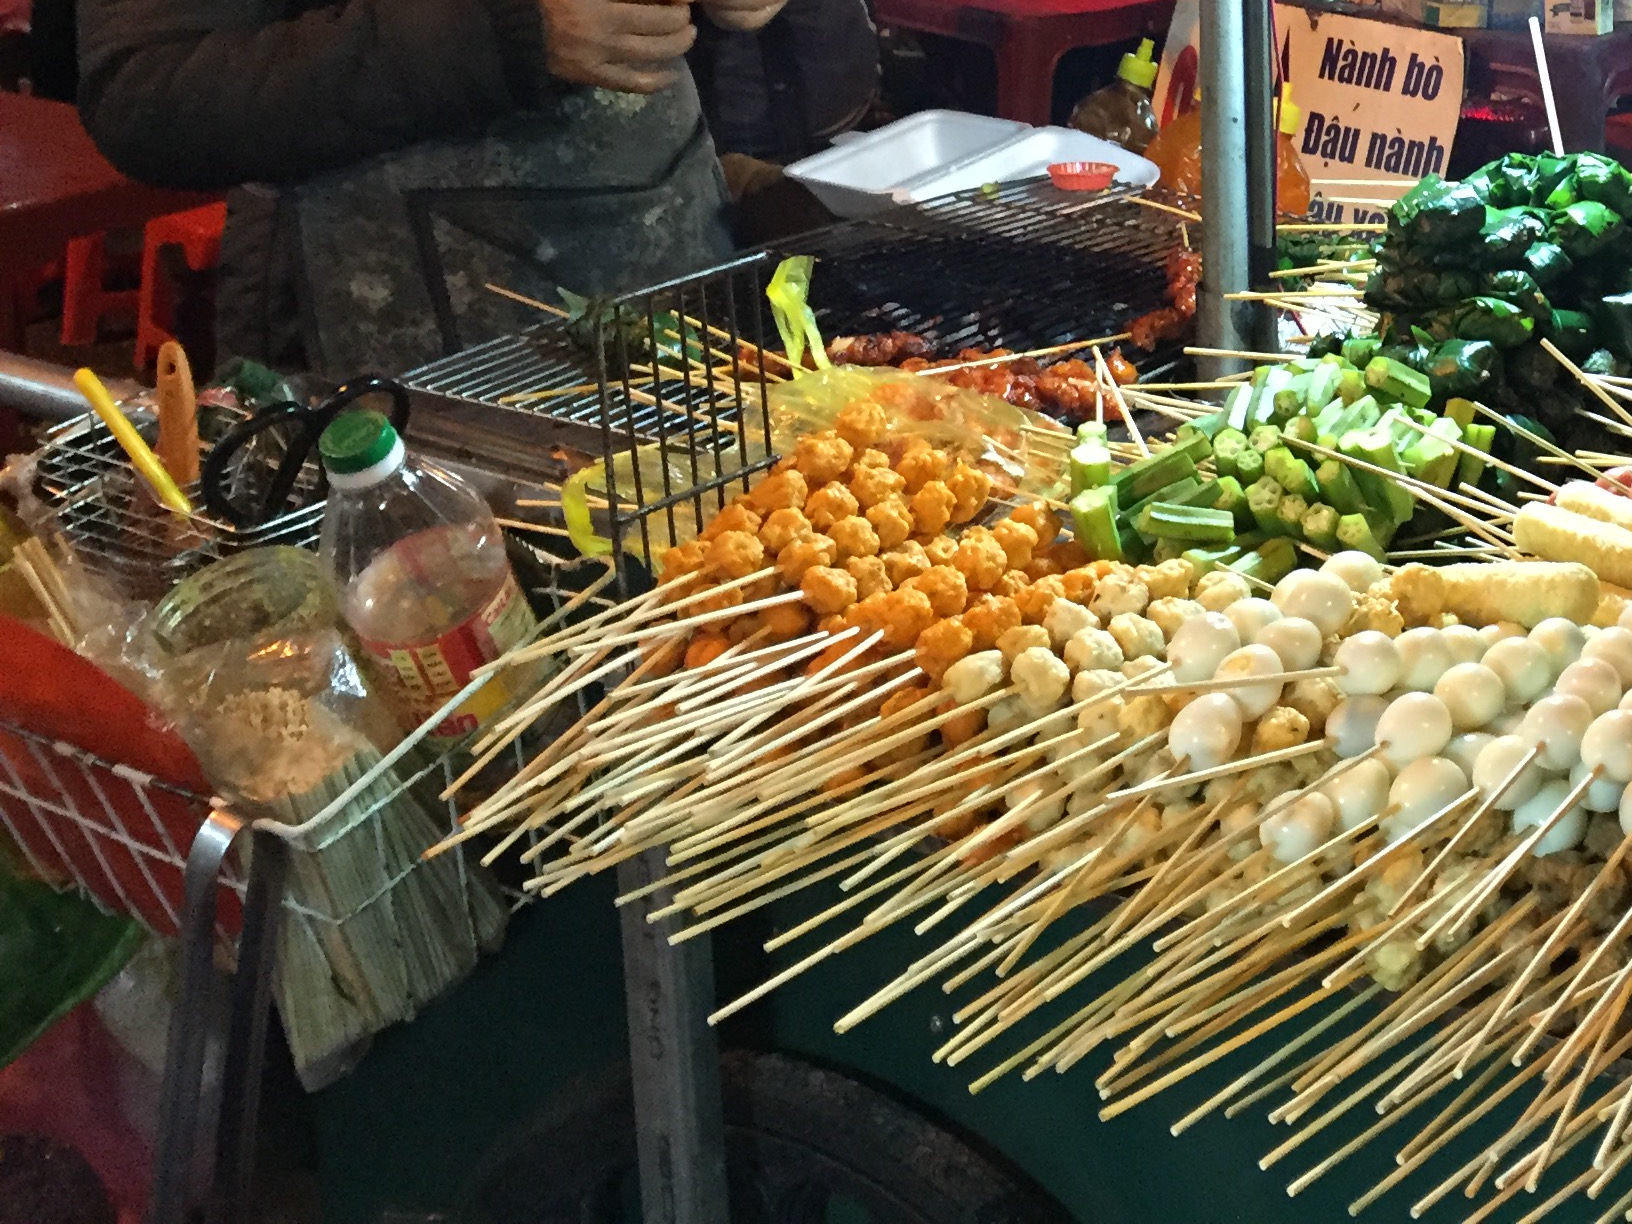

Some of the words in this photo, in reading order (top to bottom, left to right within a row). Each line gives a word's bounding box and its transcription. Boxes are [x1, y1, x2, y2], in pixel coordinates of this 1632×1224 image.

[1318, 37, 1397, 93] Nành
[1401, 52, 1444, 101] bò
[1364, 128, 1445, 180] nành
